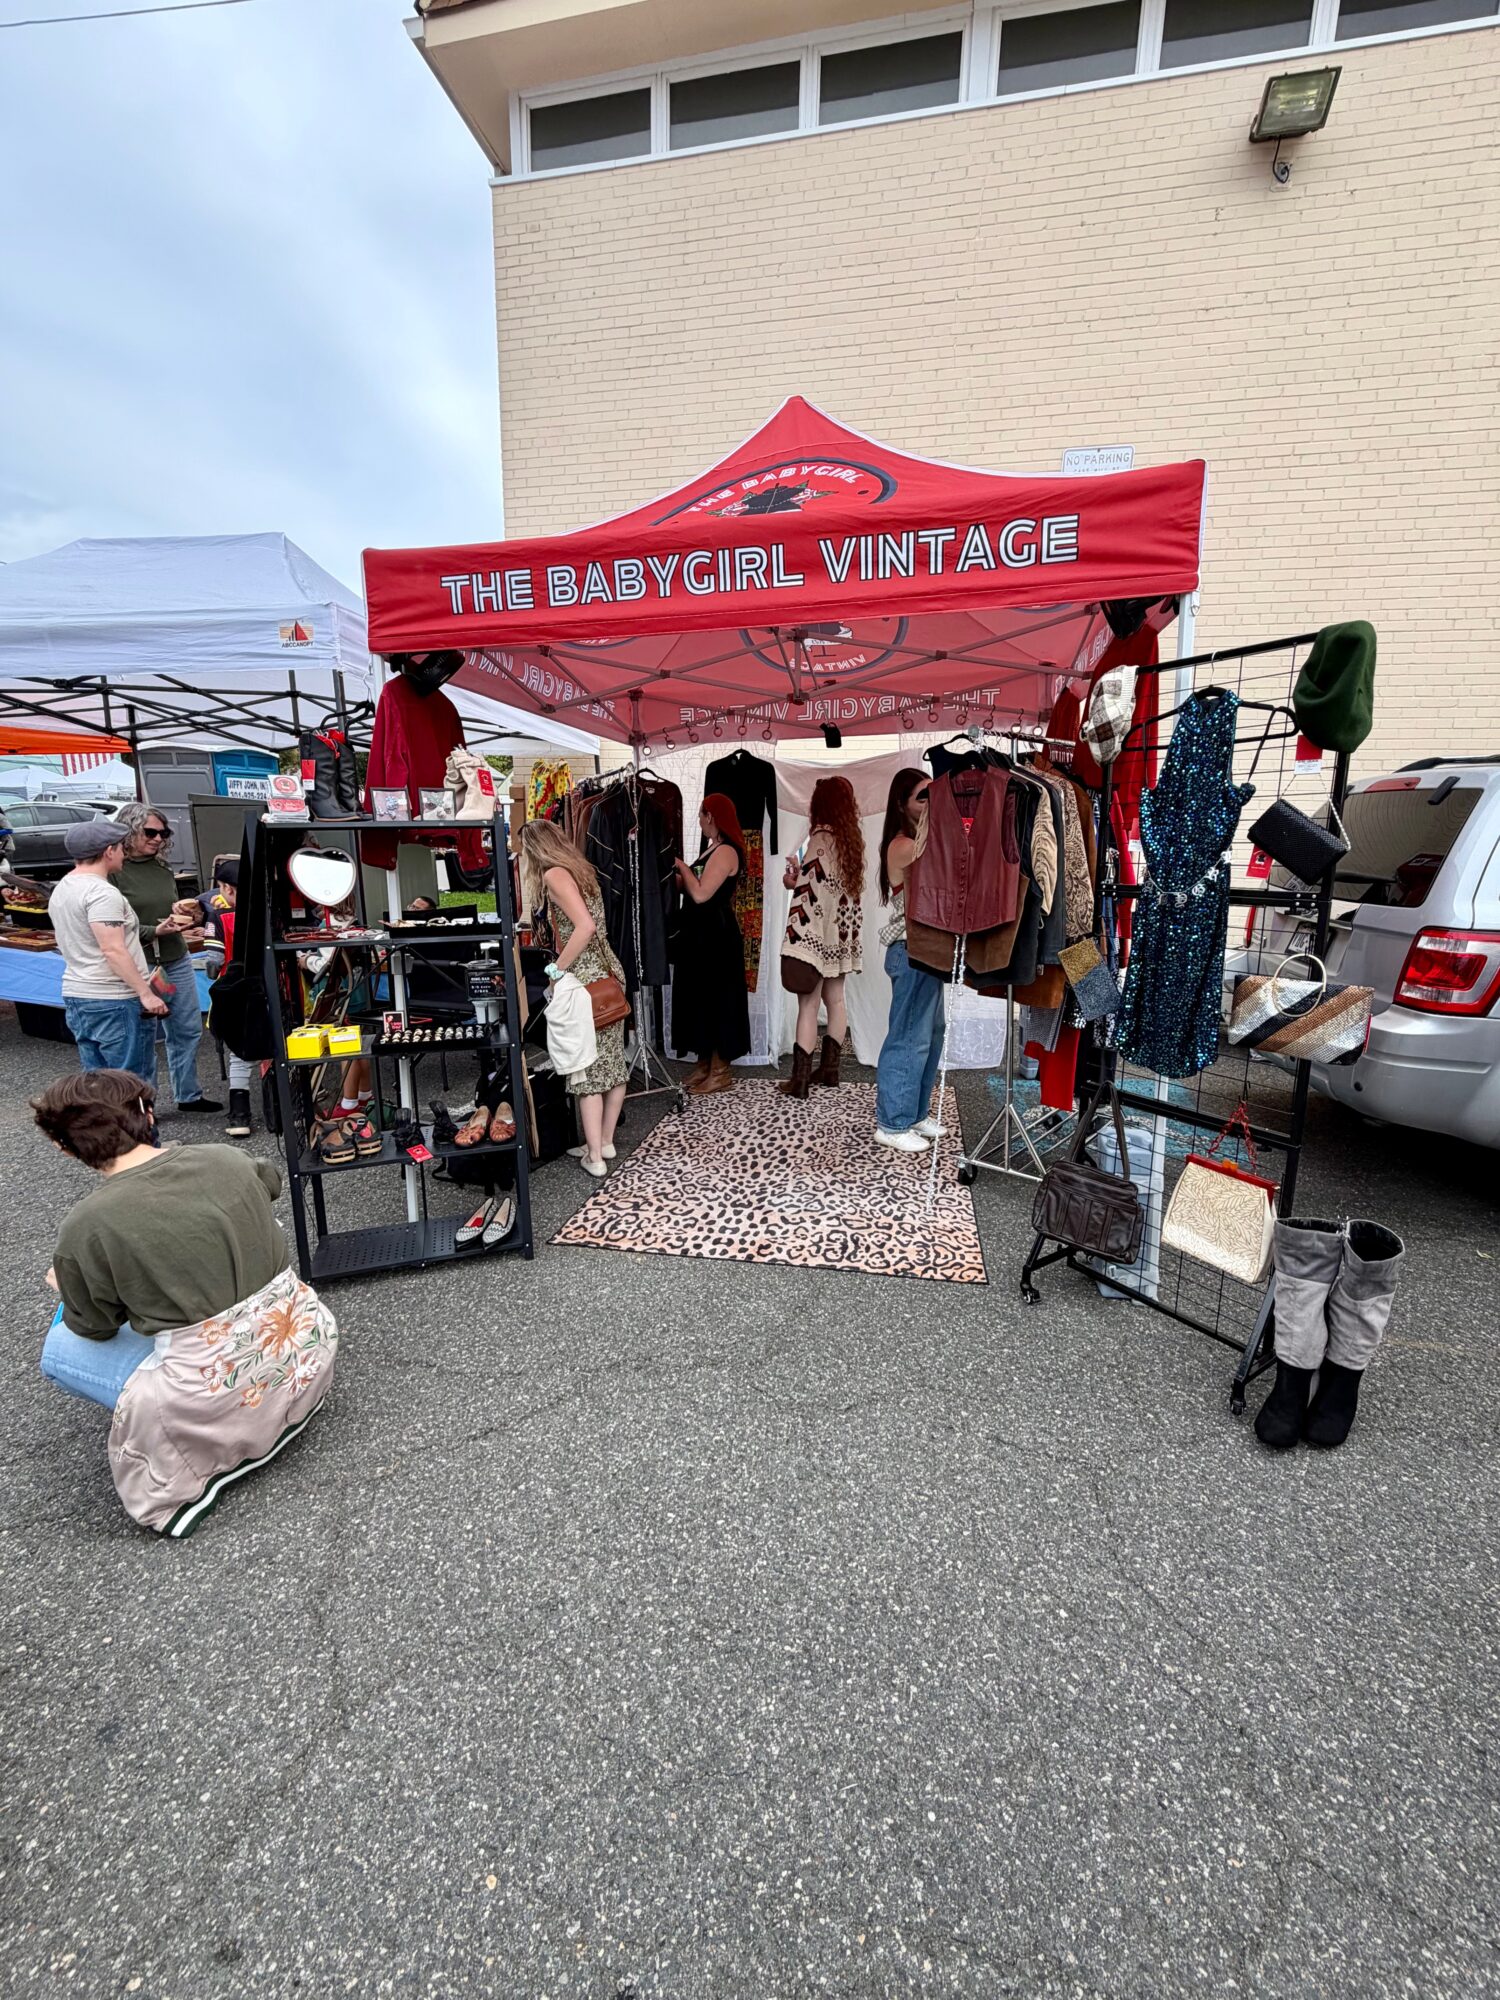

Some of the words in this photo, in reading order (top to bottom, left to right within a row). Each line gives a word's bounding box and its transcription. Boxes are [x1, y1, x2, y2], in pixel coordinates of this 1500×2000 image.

[1066, 455, 1081, 467] NO
[1084, 452, 1131, 466] PARKING
[683, 488, 736, 515] THE
[741, 464, 865, 491] BABYGIRL
[440, 567, 535, 616] THE
[546, 542, 805, 609] BABYGIRL
[817, 512, 1081, 585] VINTAGE
